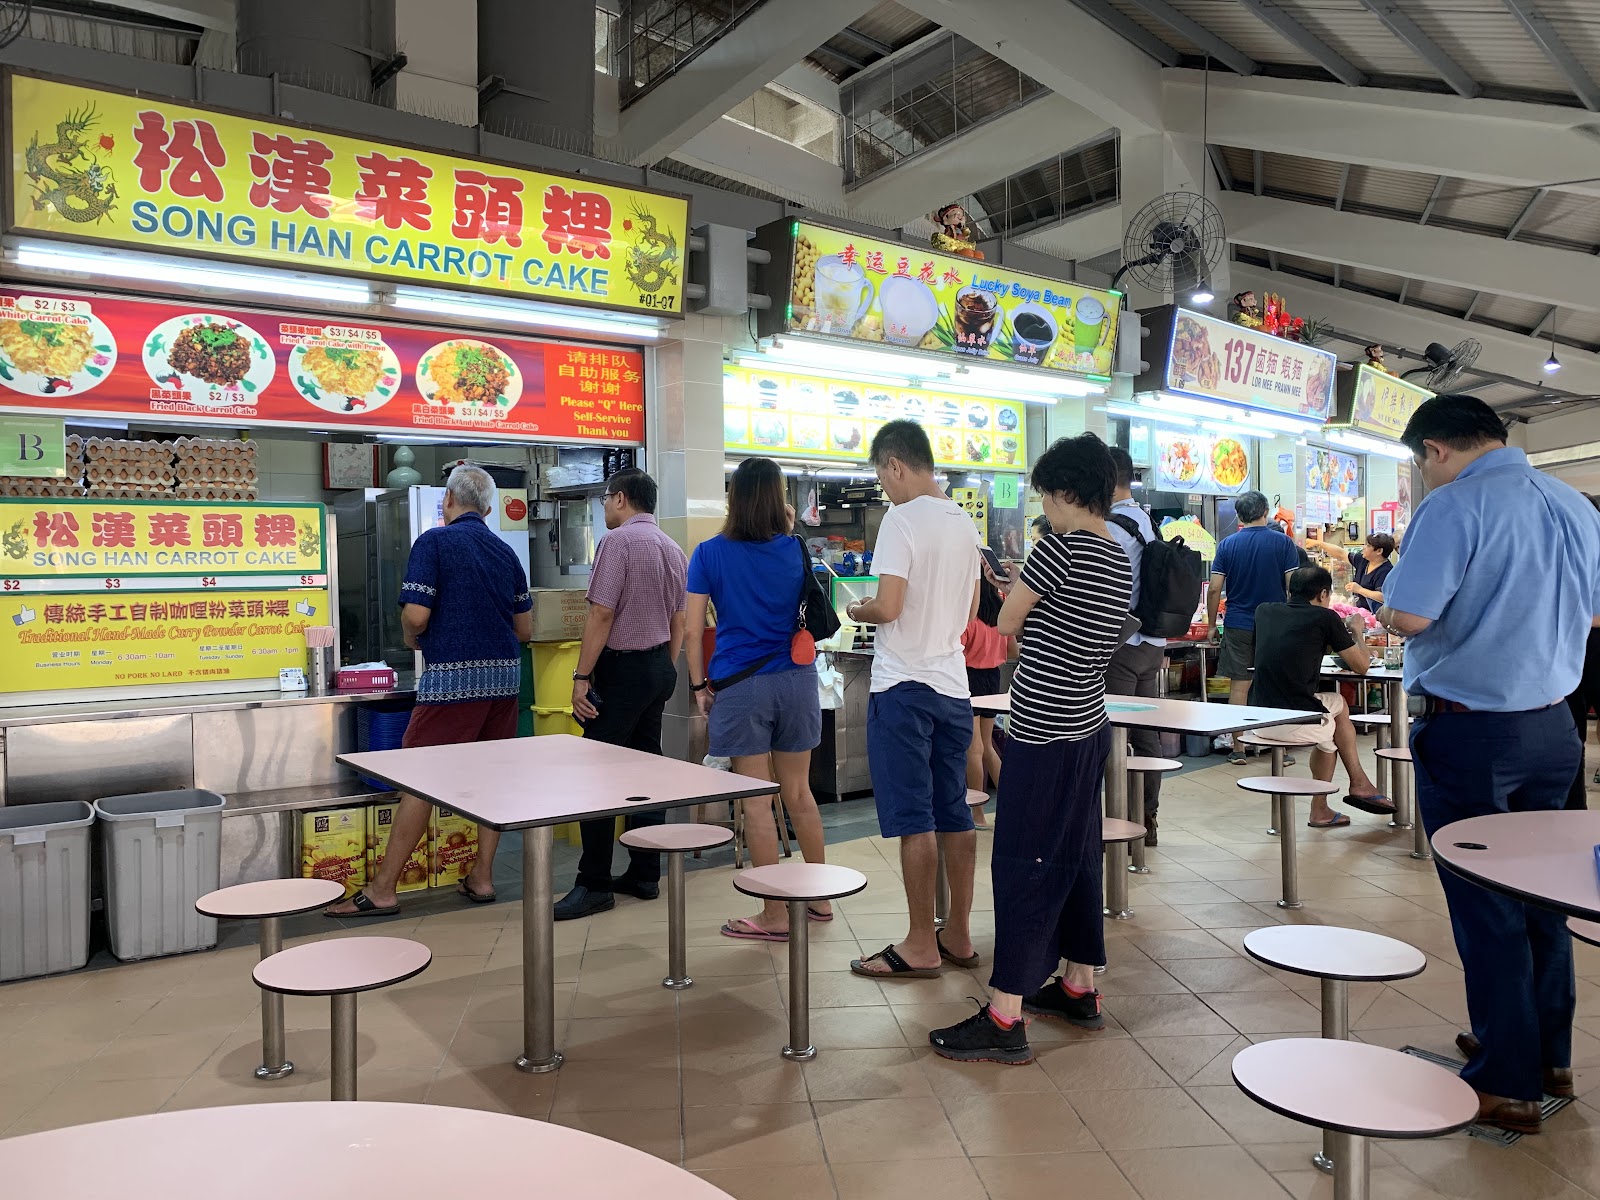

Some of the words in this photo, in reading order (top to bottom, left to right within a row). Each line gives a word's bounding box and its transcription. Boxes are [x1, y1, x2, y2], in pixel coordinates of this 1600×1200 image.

[133, 110, 613, 261] 松漢菜頭粿
[131, 200, 257, 246] SONG
[270, 220, 352, 260] HAN
[365, 235, 513, 281] CARROT
[522, 258, 609, 296] CAKE
[838, 243, 962, 287] 幸运豆花水
[971, 274, 1010, 297] Lucky
[1012, 282, 1041, 303] Soya
[1043, 290, 1072, 308] Bean
[34, 300, 49, 310] $2
[61, 302, 76, 312] $3
[639, 293, 675, 309] #01-07
[0, 311, 26, 320] White
[29, 312, 61, 323] Carrot
[65, 316, 88, 325] Cake
[330, 327, 341, 337] $3
[348, 329, 359, 338] $4
[365, 331, 377, 340] $5
[281, 336, 300, 344] Fried
[302, 338, 325, 346] Carrot
[328, 340, 345, 348] Cake
[347, 341, 361, 349] with
[364, 343, 386, 351] Prawn
[566, 350, 631, 369] 请排队
[1224, 338, 1256, 385] 137
[558, 364, 642, 384] 自助服务
[579, 380, 621, 396] 谢谢
[1251, 376, 1262, 388] LOR
[1262, 378, 1273, 391] MEE
[1274, 381, 1291, 395] PRAWN
[1291, 385, 1302, 397] MEE
[209, 391, 222, 401] $2
[232, 393, 245, 402] $3
[560, 396, 595, 408] Please
[619, 401, 643, 412] Here
[151, 402, 174, 411] Fried
[177, 404, 203, 412] Black
[204, 405, 233, 413] Carrot
[235, 407, 256, 415] Cake
[462, 407, 472, 416] $3
[478, 408, 488, 417] $4
[494, 409, 505, 418] $5
[414, 416, 433, 424] Fried
[435, 417, 458, 425] Black
[474, 420, 494, 428] White
[573, 411, 632, 425] Self-Servive
[576, 424, 608, 436] Thank
[611, 429, 629, 438] you
[18, 433, 44, 461] B
[1002, 482, 1011, 499] B
[33, 511, 297, 548] 松漢菜頭粿
[33, 552, 97, 566] SONG
[104, 552, 148, 566] HAN
[155, 551, 239, 566] CARROT
[245, 551, 297, 565] CAKE
[4, 579, 20, 591] $2
[105, 578, 121, 589] $3
[202, 577, 216, 587] $4
[300, 575, 314, 585] $5
[18, 626, 90, 644] Traditional
[92, 624, 165, 642] Hand-Made
[168, 625, 200, 642] Curry
[203, 622, 247, 637] Powder
[248, 622, 283, 637] Carrot
[155, 651, 175, 659] 10am
